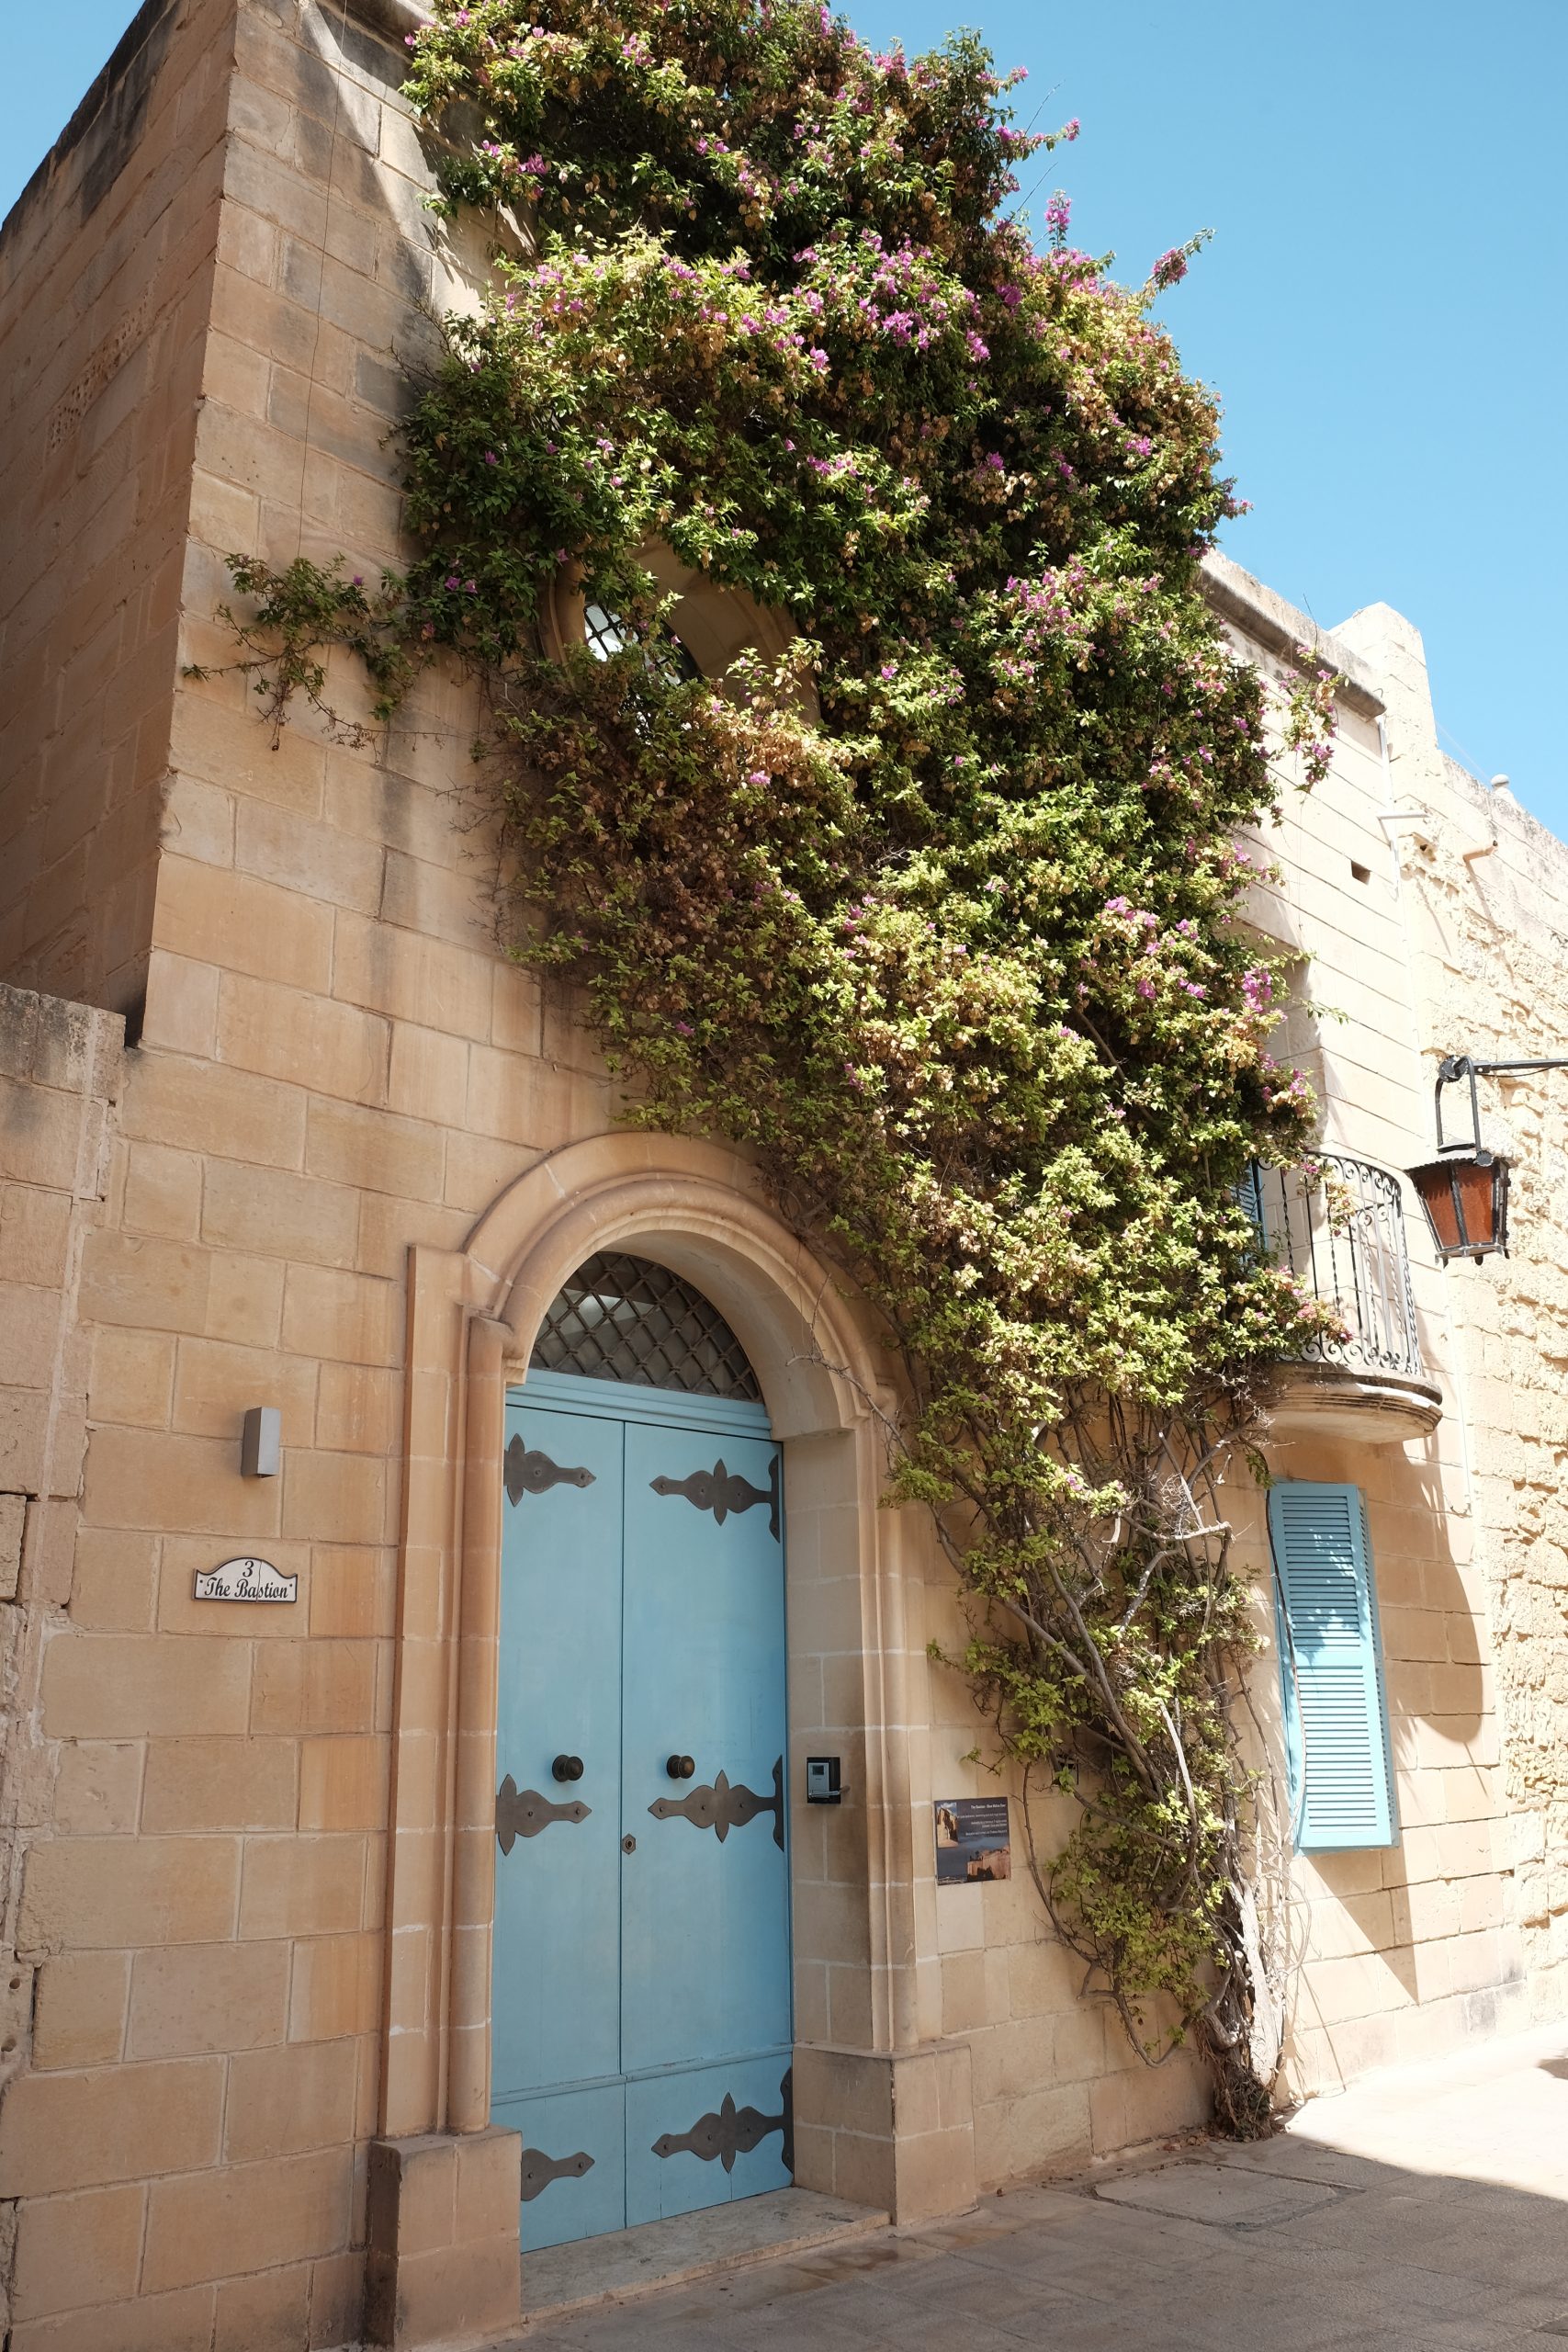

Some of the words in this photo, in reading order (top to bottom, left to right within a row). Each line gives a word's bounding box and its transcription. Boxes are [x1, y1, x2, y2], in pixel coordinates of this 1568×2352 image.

[243, 1560, 254, 1577] 3
[204, 1577, 231, 1597] The
[234, 1578, 288, 1599] Bastion
